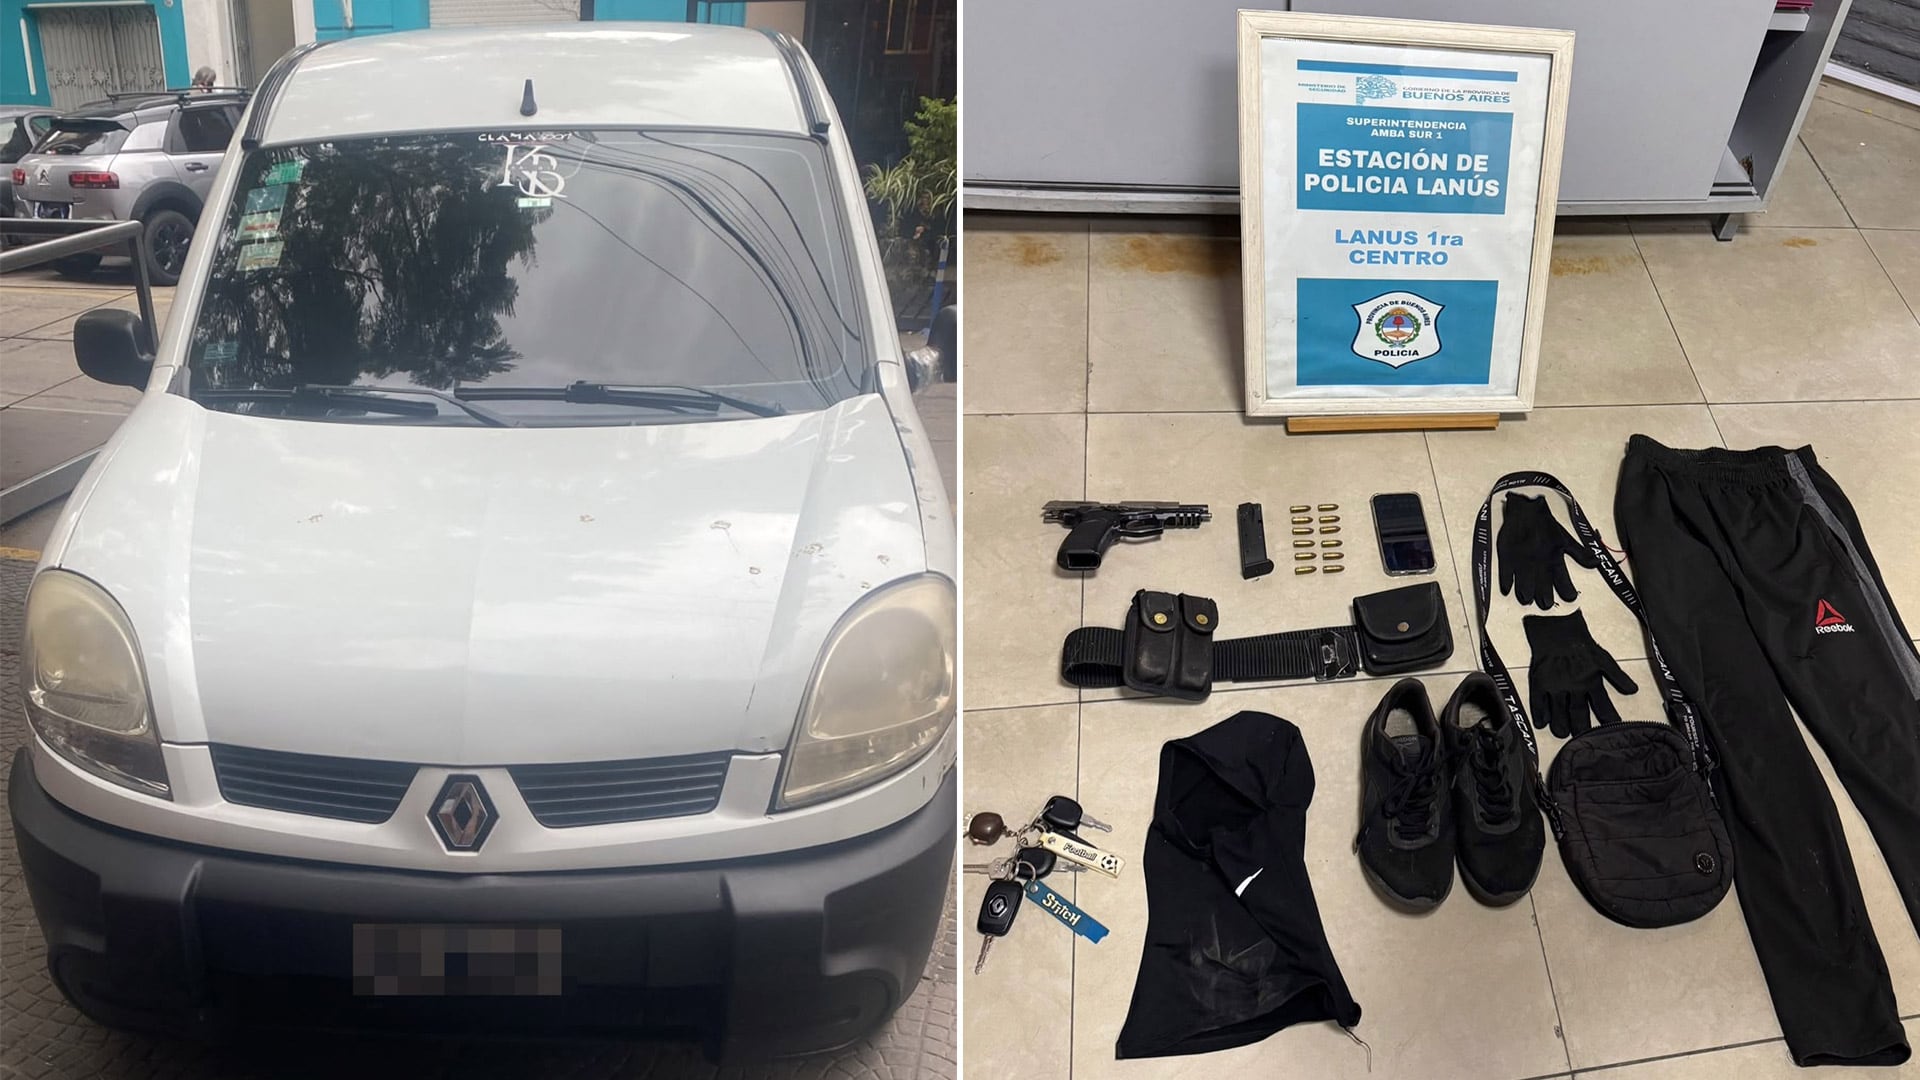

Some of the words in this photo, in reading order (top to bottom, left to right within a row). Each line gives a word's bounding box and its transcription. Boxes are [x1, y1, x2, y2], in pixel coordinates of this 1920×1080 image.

[1402, 91, 1465, 101] BUENOS
[1468, 94, 1511, 103] AIRES
[1346, 117, 1467, 130] SUPERINTENDENCIA
[1371, 129, 1405, 138] AMBA
[1408, 130, 1432, 139] SUR
[1436, 131, 1443, 139] 1
[1319, 148, 1448, 171] ESTACIÓN
[1456, 153, 1489, 172] DE
[1304, 173, 1408, 194] POLICIA
[1416, 175, 1500, 197] LANÚS
[1335, 229, 1418, 245] LANUS
[1427, 231, 1464, 246] 1ra
[1349, 250, 1449, 265] CENTRO
[1366, 302, 1389, 324] PROVINCIA
[1400, 300, 1426, 314] BUENOS
[1422, 310, 1431, 327] AIRES
[1374, 349, 1420, 357] POLICIA
[1588, 540, 1623, 586] TASCANI
[1815, 623, 1856, 635] Reebok
[1063, 842, 1098, 862] Football
